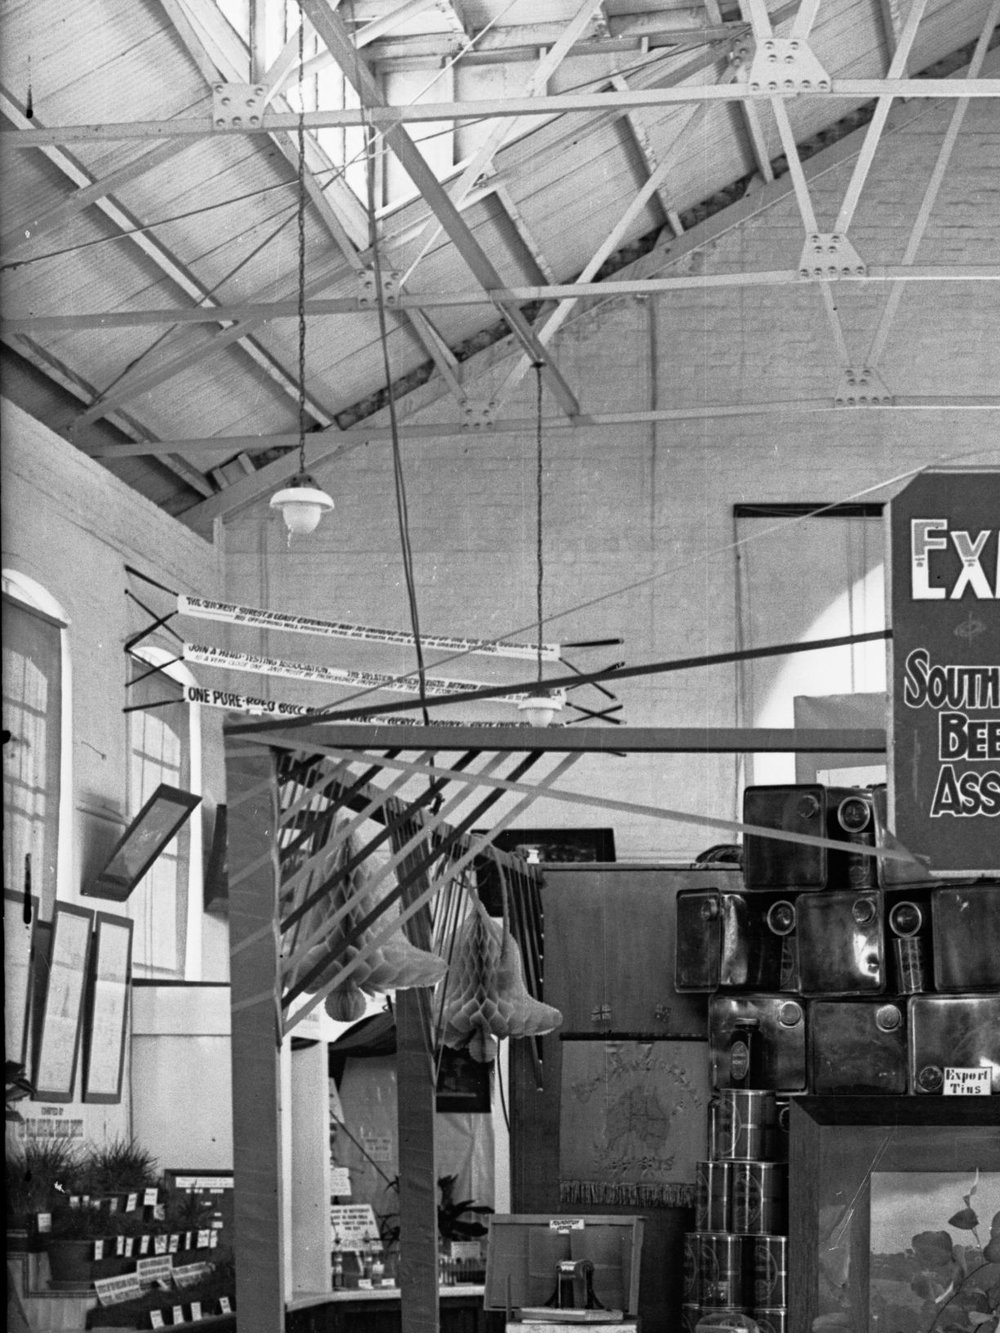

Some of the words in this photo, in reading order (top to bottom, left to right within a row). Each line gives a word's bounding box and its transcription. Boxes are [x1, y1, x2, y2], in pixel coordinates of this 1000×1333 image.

[188, 644, 208, 654] JOIN
[904, 648, 1000, 708] SOUTH
[188, 687, 210, 704] ONE
[946, 1070, 987, 1083] Export
[950, 1084, 981, 1094] Tins
